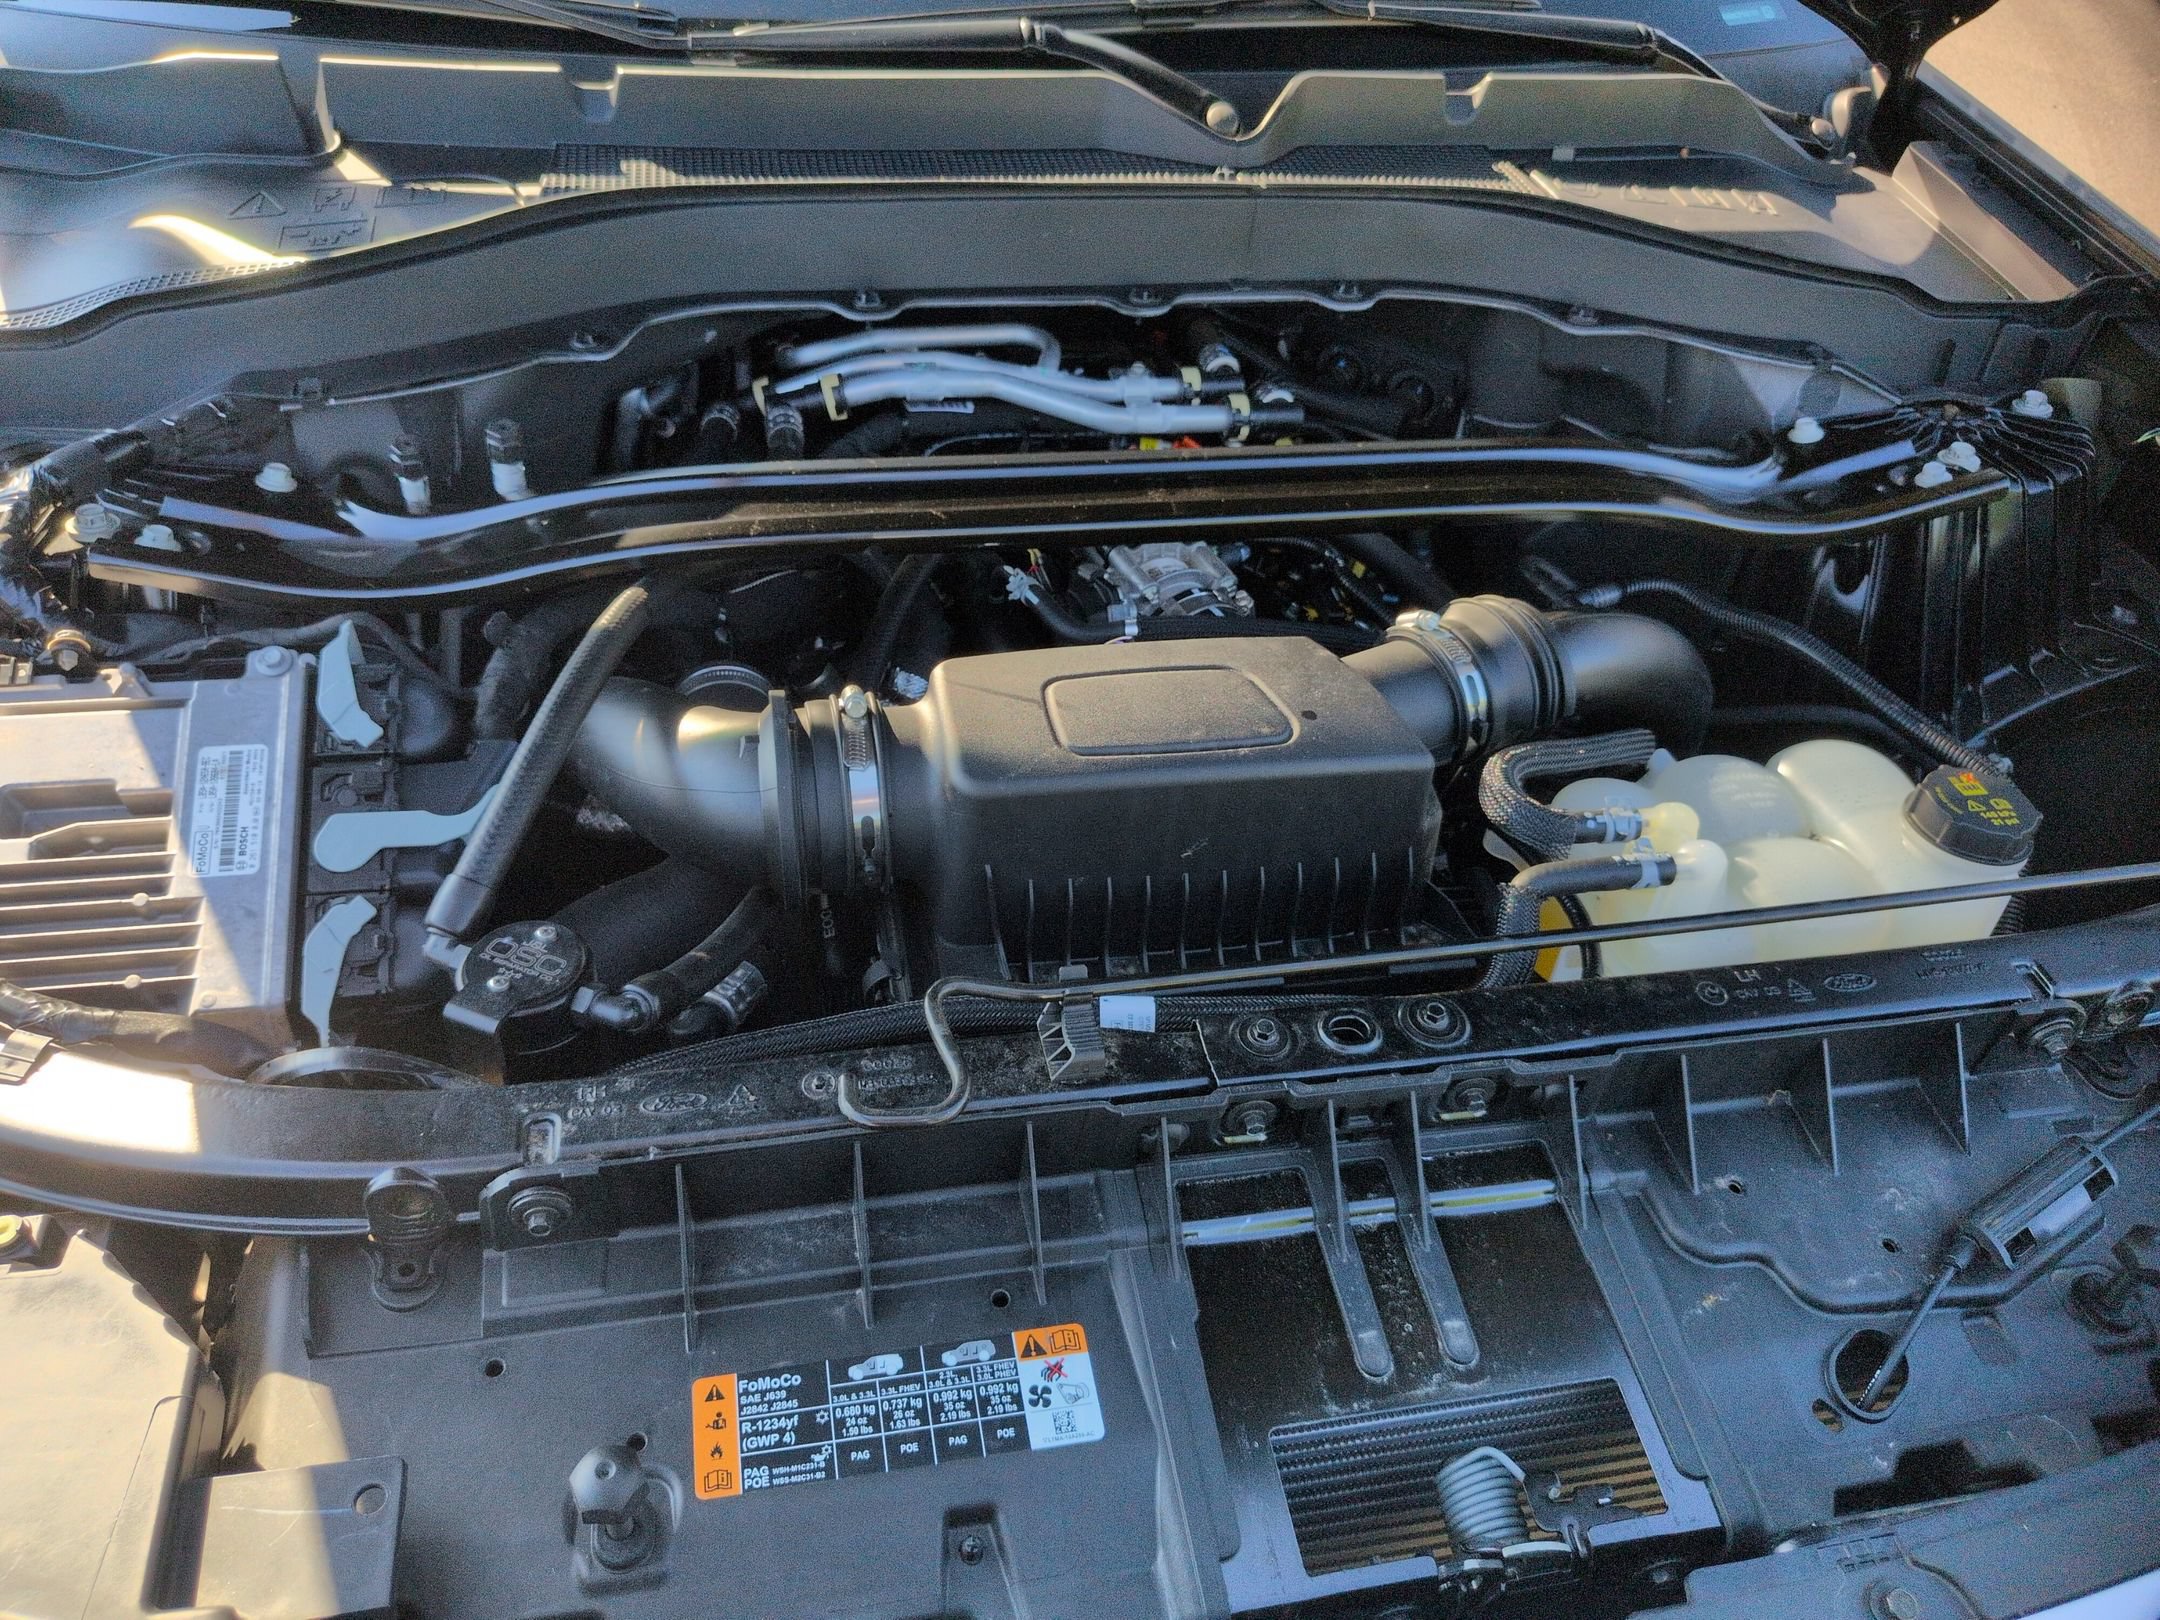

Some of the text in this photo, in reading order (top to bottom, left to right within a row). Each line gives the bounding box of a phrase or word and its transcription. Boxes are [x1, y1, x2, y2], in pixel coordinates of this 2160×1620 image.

[238, 826, 249, 857] BOSCH
[196, 832, 209, 873] FoMoCo
[485, 937, 567, 976] OSC
[641, 1093, 707, 1113] Ford
[993, 1361, 1015, 1370] FHEV
[738, 1373, 802, 1394] FoMoCo
[899, 1383, 921, 1393] FHEV
[980, 1382, 1019, 1397] 0.992 kg
[740, 1390, 787, 1405] SAE J639
[850, 1393, 857, 1401] &
[933, 1389, 973, 1403] 0.992 kg
[990, 1394, 1012, 1405] 35 oz
[740, 1399, 799, 1416] J2842 J2845
[835, 1403, 876, 1418] 0.680 kg
[882, 1397, 923, 1412] 0.737 kg
[943, 1401, 966, 1411] 35 oz
[987, 1403, 1018, 1415] 2.19 lbs
[893, 1409, 915, 1420] 26 oz
[940, 1409, 971, 1422] 2.19 lbs
[741, 1414, 799, 1434] R-1234yf
[846, 1416, 868, 1427] 24 oz
[890, 1417, 921, 1430] 1.63 lbs
[860, 1425, 873, 1434] lbs
[997, 1427, 1016, 1439] POE
[742, 1430, 796, 1452] (GWP 4)
[948, 1434, 968, 1446] PAG
[850, 1449, 871, 1461] PAG
[900, 1442, 920, 1455] POE
[743, 1465, 769, 1479] PAG
[744, 1476, 770, 1490] POE
